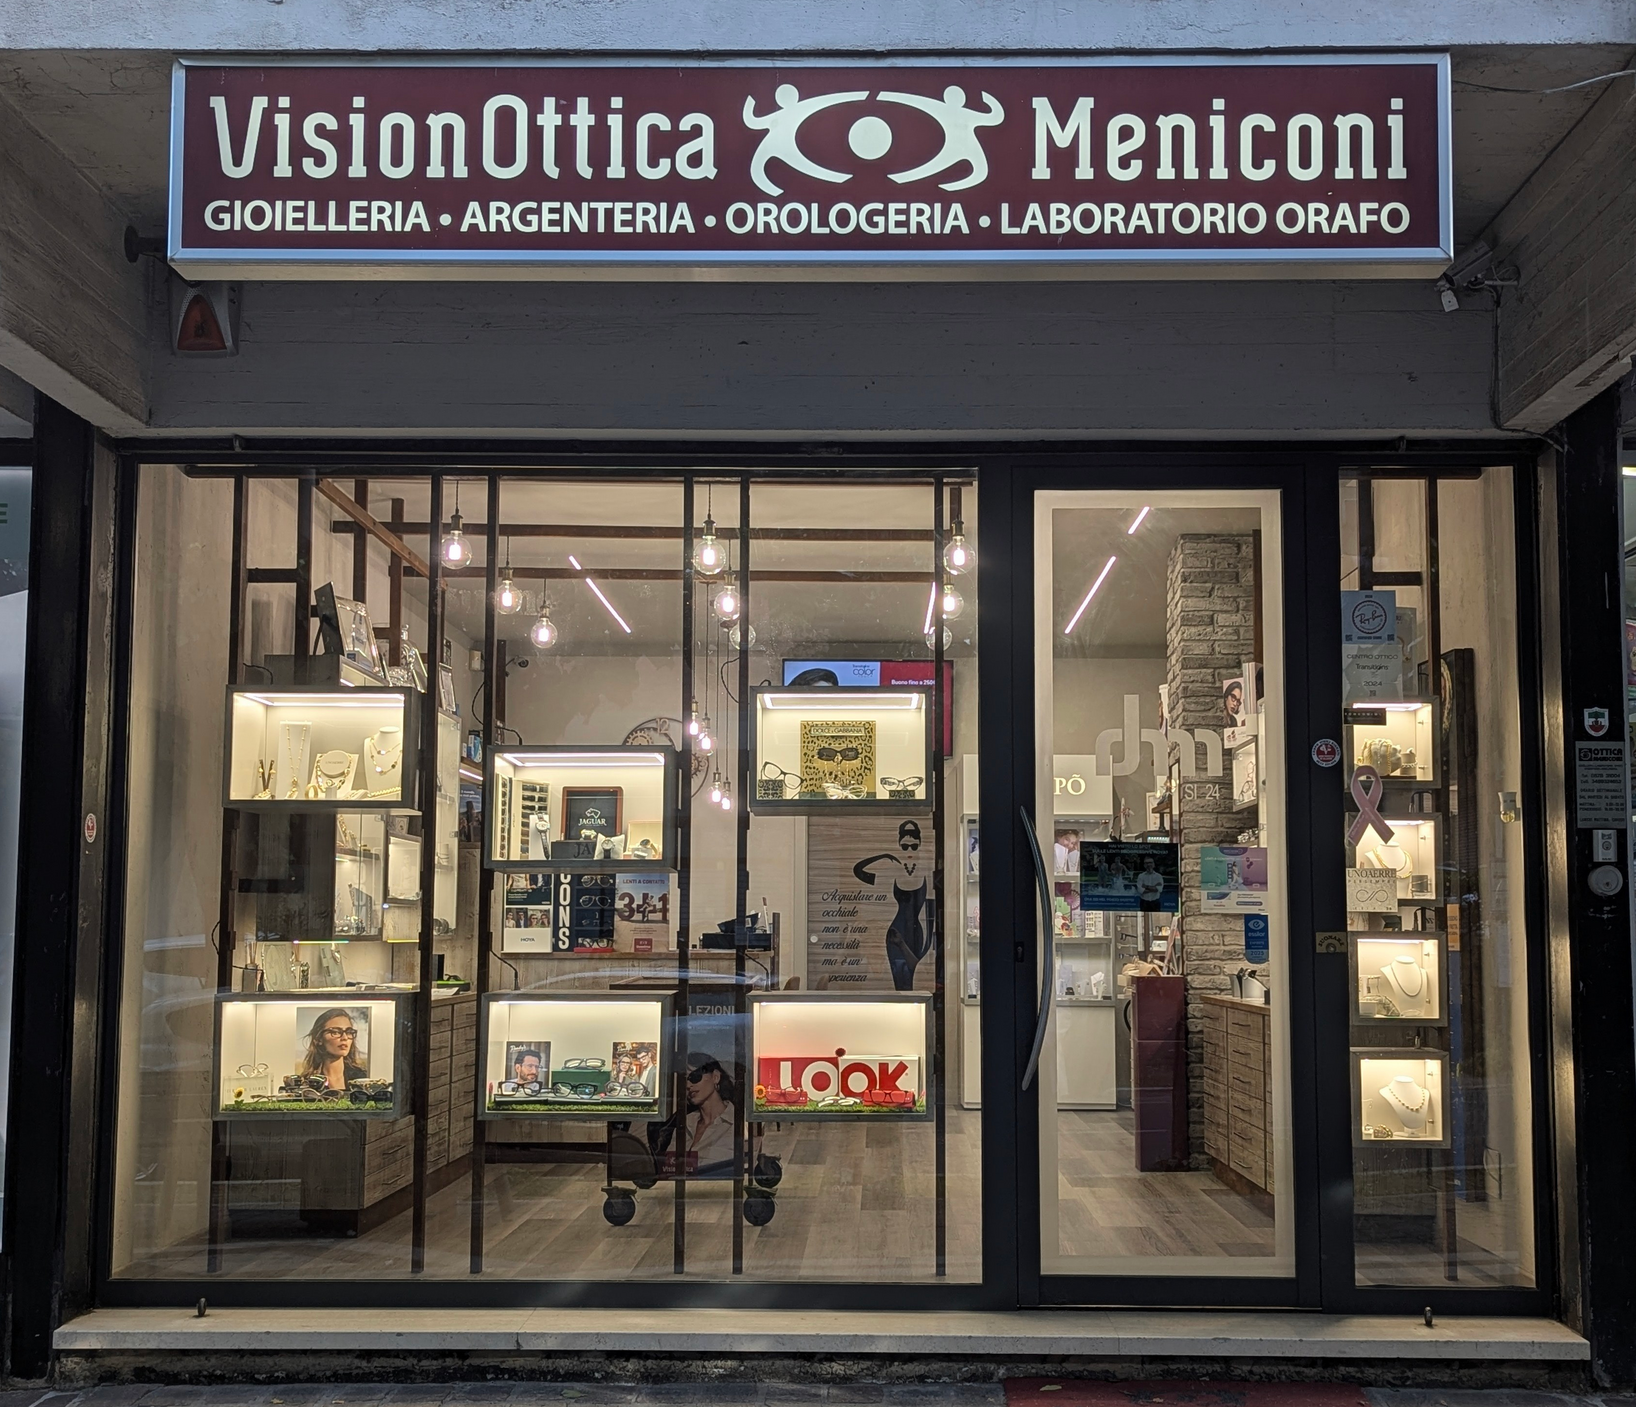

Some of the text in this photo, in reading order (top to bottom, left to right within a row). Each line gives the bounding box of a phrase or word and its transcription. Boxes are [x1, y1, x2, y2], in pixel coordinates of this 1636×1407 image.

[209, 94, 1408, 181] VisionOttica Meniconi
[204, 199, 1411, 235] GIOIELLERIA ARGENTERIA OROLOGERIA LABORATORIO ORAFO
[1355, 663, 1389, 671] Transitions
[655, 718, 670, 734] 12
[812, 727, 831, 735] DOLCE
[833, 727, 863, 735] GABBANA
[1592, 748, 1624, 756] OTTICA
[1205, 784, 1220, 800] 24
[578, 817, 608, 827] JAGUAR
[573, 842, 594, 859] JA
[1347, 869, 1397, 878] UNOAERRE
[821, 888, 888, 905] Acquistare un
[821, 905, 859, 918] occhiale
[821, 923, 868, 934] non è una
[821, 938, 861, 950] necessità
[840, 956, 848, 966] è
[828, 972, 868, 983] perienza
[779, 1060, 909, 1103] LOOK
